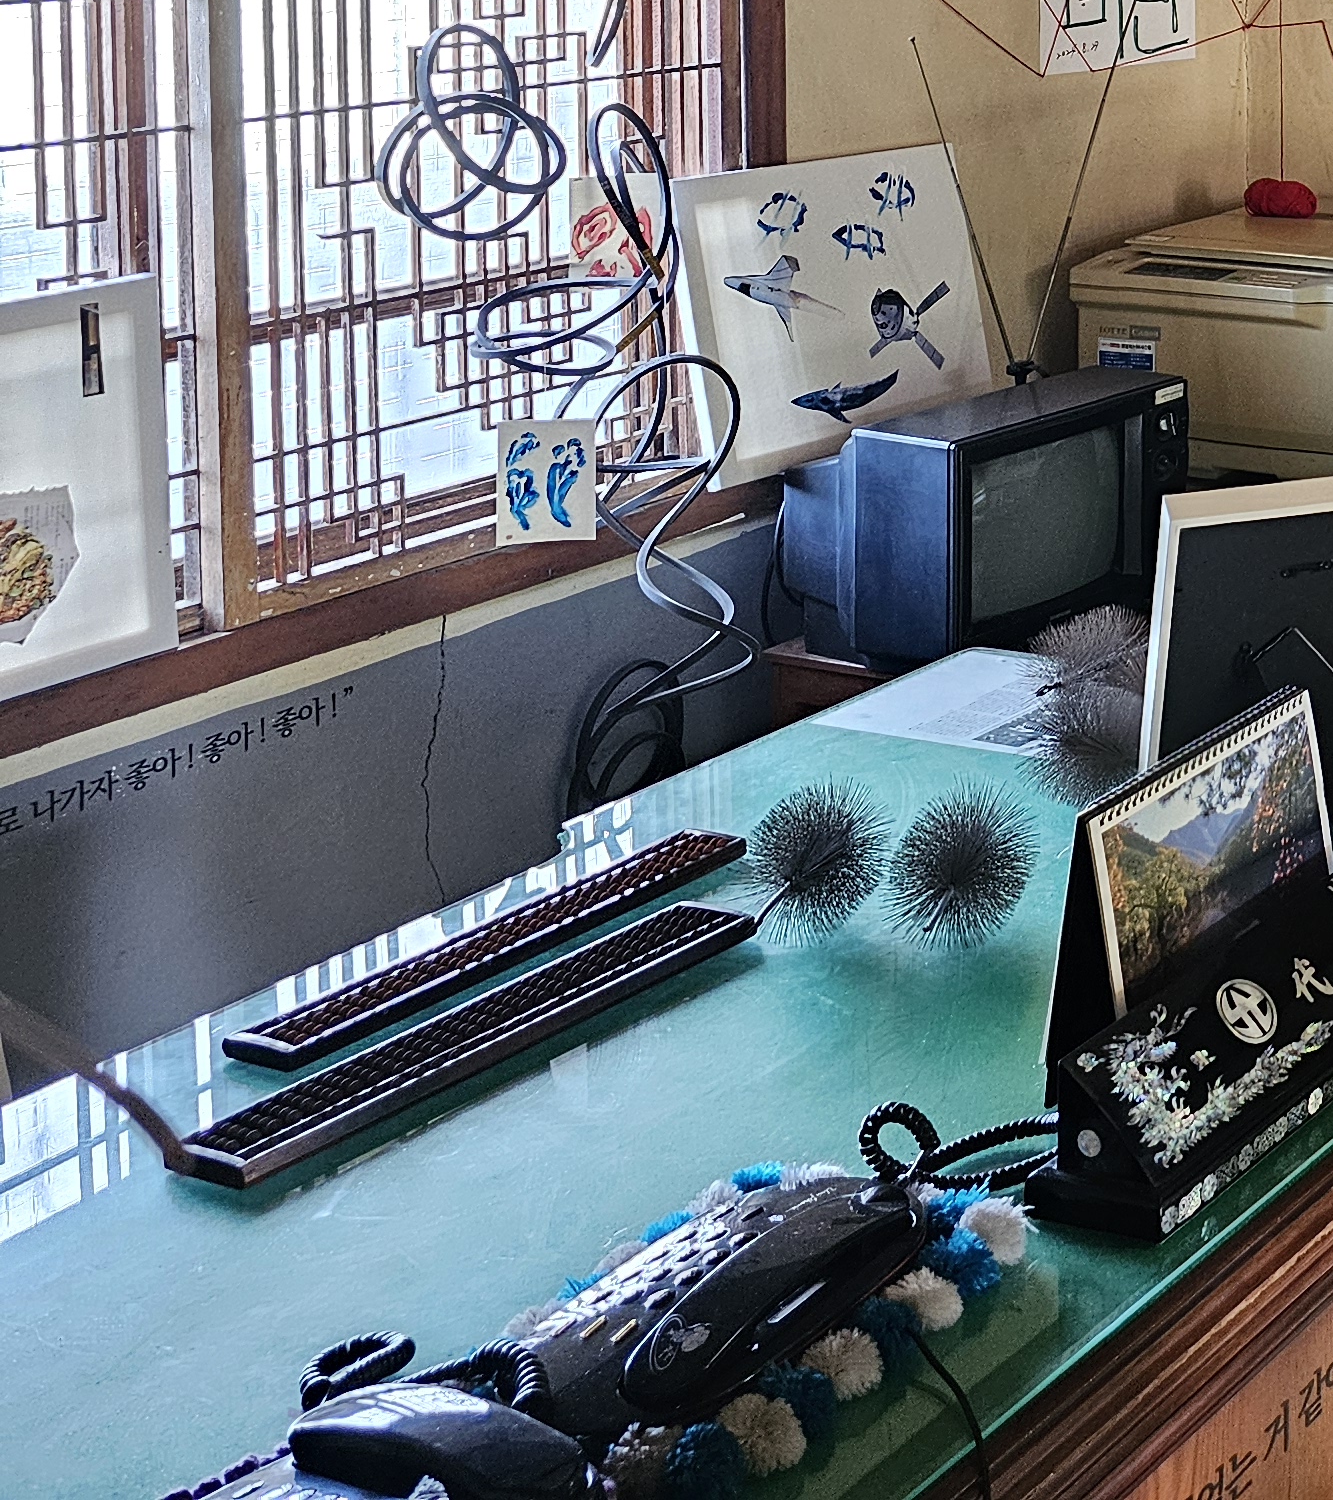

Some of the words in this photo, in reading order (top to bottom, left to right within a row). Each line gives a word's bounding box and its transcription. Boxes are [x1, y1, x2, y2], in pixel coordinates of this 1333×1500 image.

[31, 769, 120, 823] 나가자
[125, 743, 194, 791] 좋아!
[200, 716, 266, 764] 좋아!
[1263, 1398, 1290, 1462] 거
